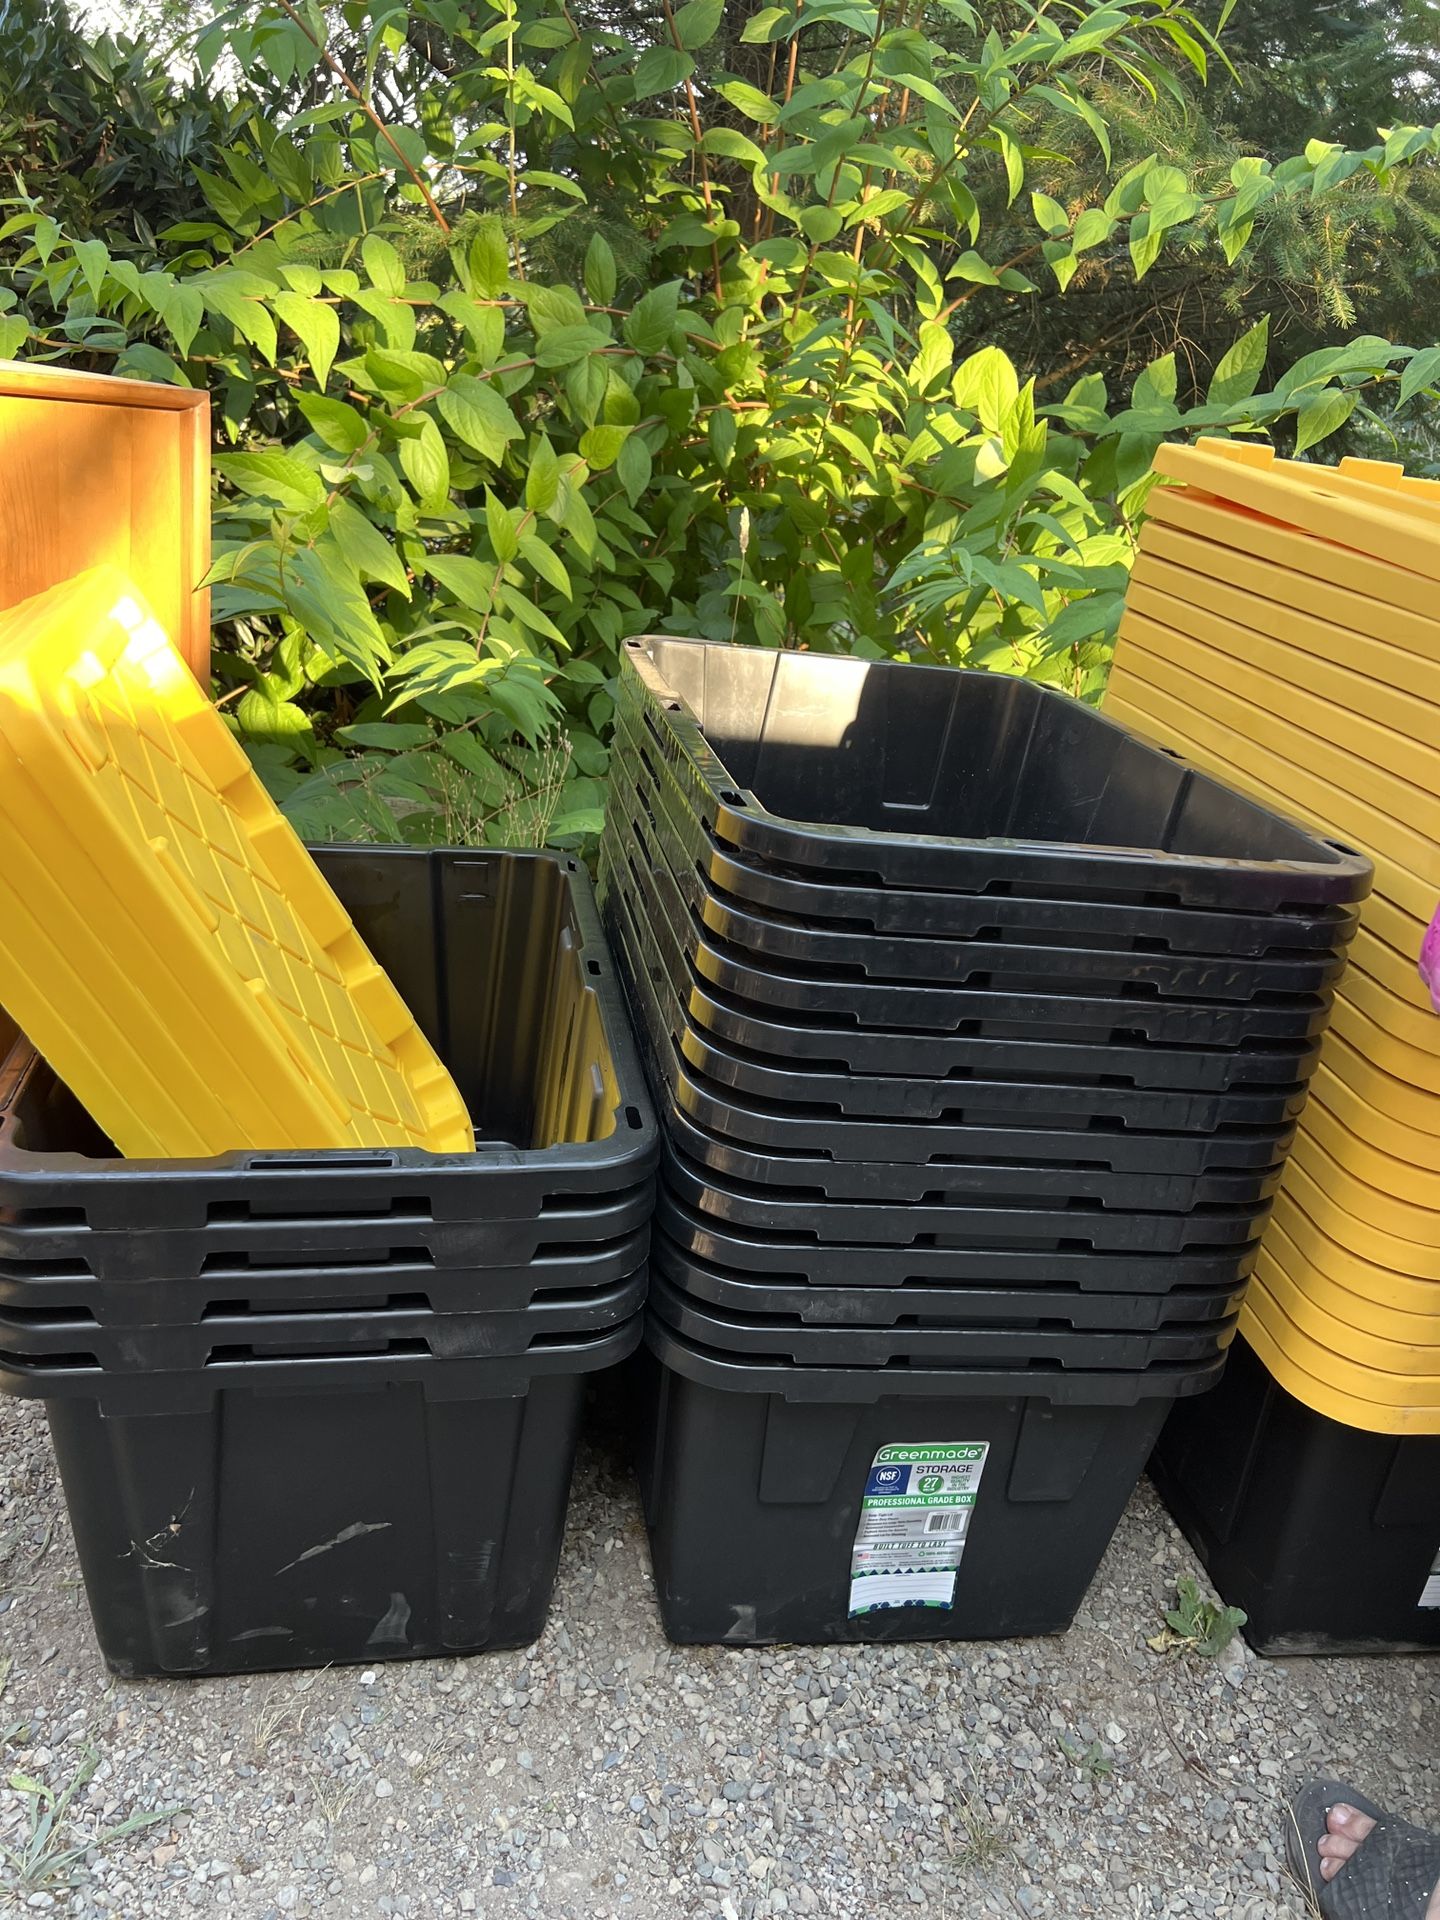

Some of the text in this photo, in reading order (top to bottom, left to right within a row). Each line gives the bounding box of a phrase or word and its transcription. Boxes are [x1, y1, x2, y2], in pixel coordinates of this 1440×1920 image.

[916, 1464, 974, 1474] STORAGE
[879, 1471, 897, 1481] NSF
[923, 1477, 939, 1488] 27
[867, 1495, 972, 1506] PROFESSIONAL GRADE BOX
[873, 1542, 896, 1550] BUILT
